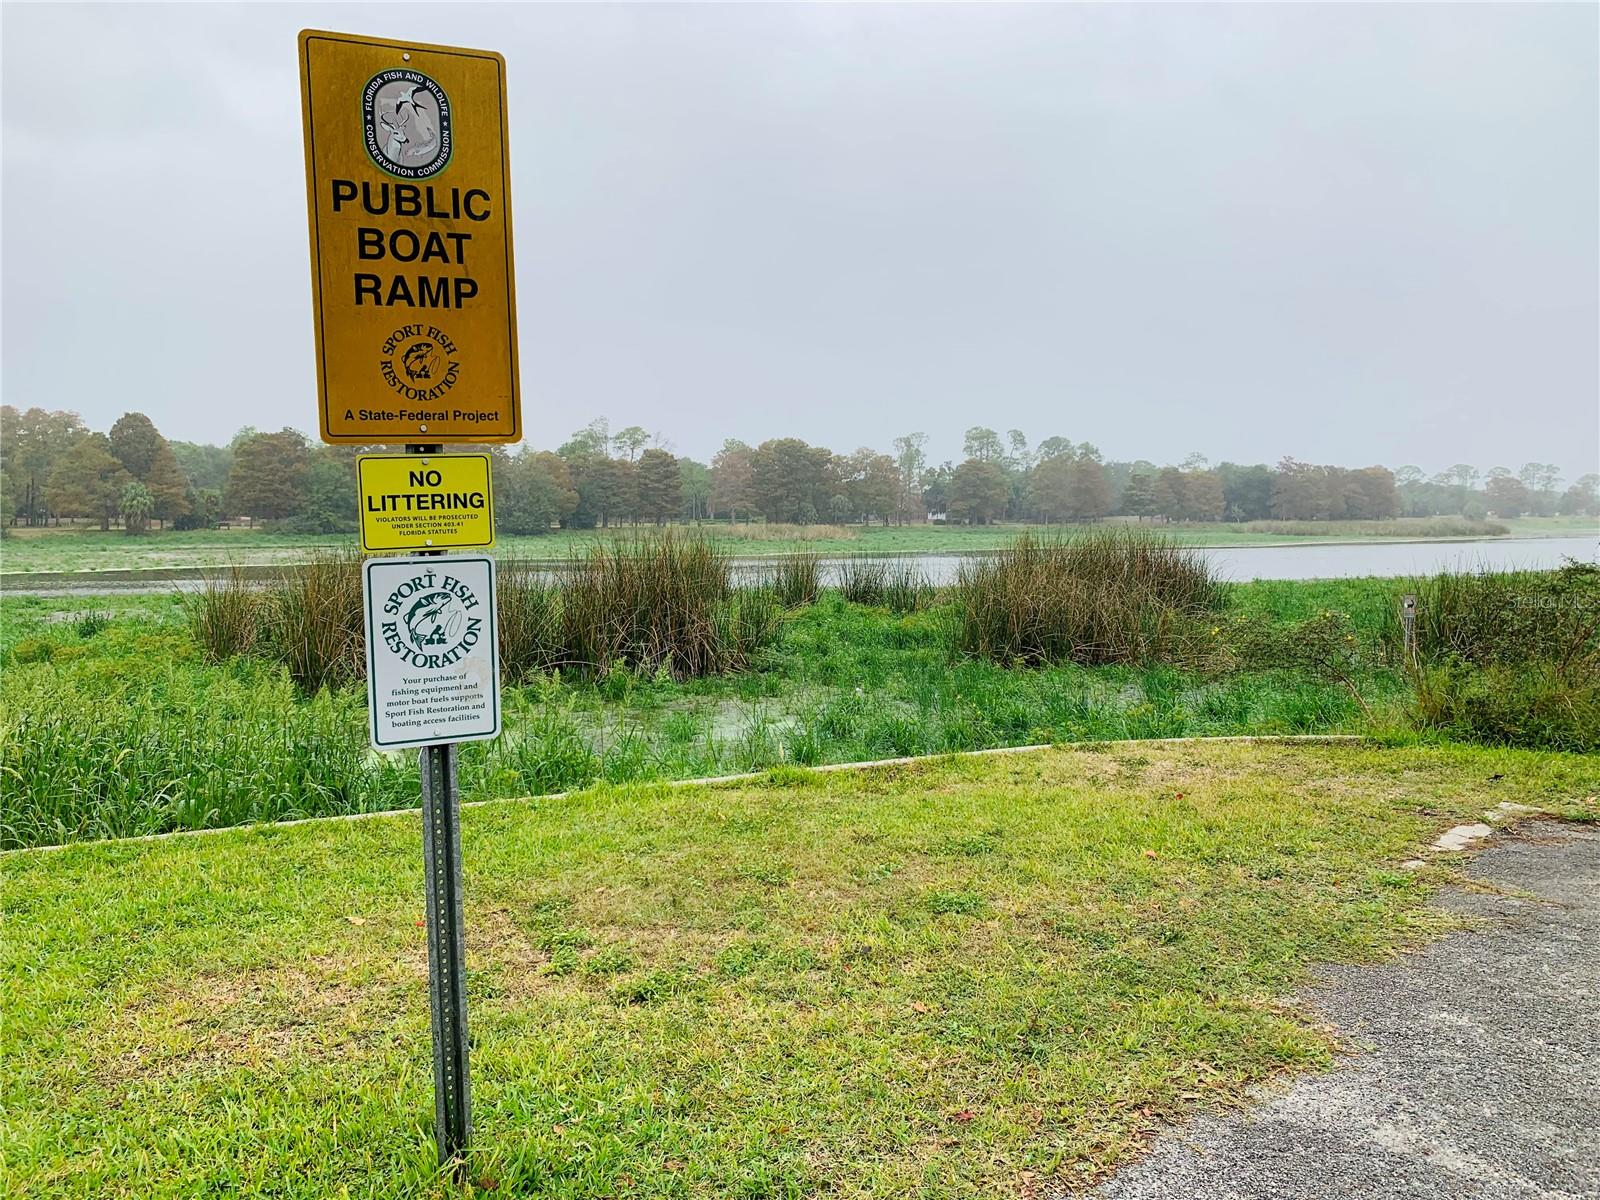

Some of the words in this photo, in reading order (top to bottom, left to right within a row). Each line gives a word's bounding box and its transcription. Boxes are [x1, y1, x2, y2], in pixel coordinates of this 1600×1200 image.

[365, 78, 384, 111] FLORIDA
[383, 71, 403, 81] FISH
[404, 72, 424, 83] AND
[425, 79, 449, 117] WILDLIFE
[366, 124, 414, 176] CONSERVATION
[417, 130, 450, 176] COMMISSION
[332, 179, 491, 222] PUBLIC
[357, 227, 472, 265] BOAT
[354, 273, 478, 309] RAMP
[382, 324, 424, 356] SPORT
[425, 325, 458, 356] FISH
[380, 360, 460, 401] RESTORATION
[344, 409, 354, 421] A
[359, 409, 449, 421] State-Federal
[453, 410, 499, 423] Project
[409, 470, 442, 487] NO
[367, 492, 484, 512] LITTERING
[438, 513, 479, 521] PROSECUTED
[383, 573, 436, 616] SPORT
[440, 575, 479, 611] FISH
[382, 616, 482, 669] RESTORATION
[391, 687, 419, 696] fishing
[421, 684, 462, 695] equipment
[464, 682, 478, 690] and
[402, 677, 421, 685] Your
[423, 674, 457, 684] purchase
[459, 672, 467, 680] of
[385, 709, 406, 719] Sport
[408, 707, 424, 716] Fish
[426, 704, 470, 714] Restoration
[471, 702, 486, 710] and
[386, 698, 410, 707] motor
[412, 696, 428, 705] boat
[430, 695, 449, 703] fuels
[450, 693, 484, 703] supports
[391, 719, 421, 728] boating
[447, 713, 480, 723] facilities
